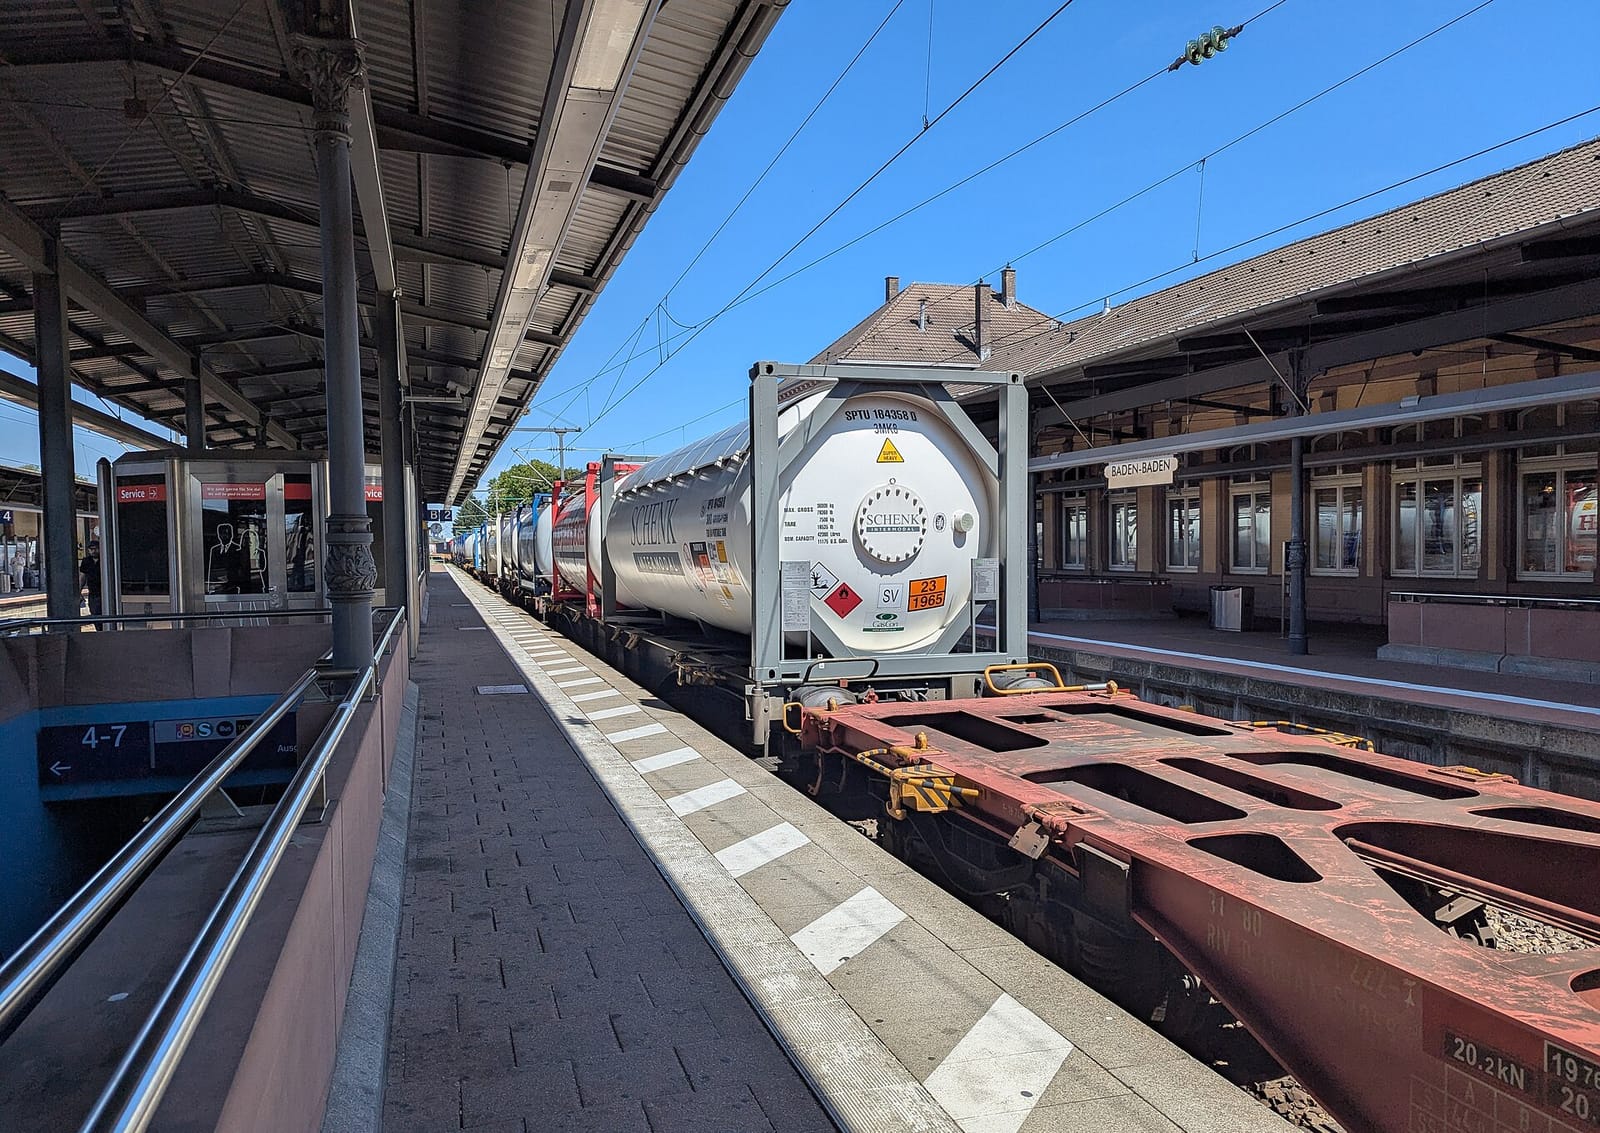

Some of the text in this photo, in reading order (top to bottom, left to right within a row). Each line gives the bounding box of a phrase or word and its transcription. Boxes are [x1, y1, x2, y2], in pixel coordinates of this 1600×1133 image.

[845, 409, 870, 421] SPTU
[1111, 459, 1171, 476] BADEN-BADEN
[120, 488, 145, 499] Service
[365, 489, 382, 498] vice
[3, 511, 11, 521] 4
[430, 510, 451, 520] B 2
[631, 498, 679, 546] SCHENK
[866, 513, 919, 525] SCHENK
[920, 579, 937, 593] 23
[882, 589, 899, 603] SV
[913, 593, 943, 608] 1965
[81, 725, 127, 749] 4-7
[198, 723, 212, 737] S
